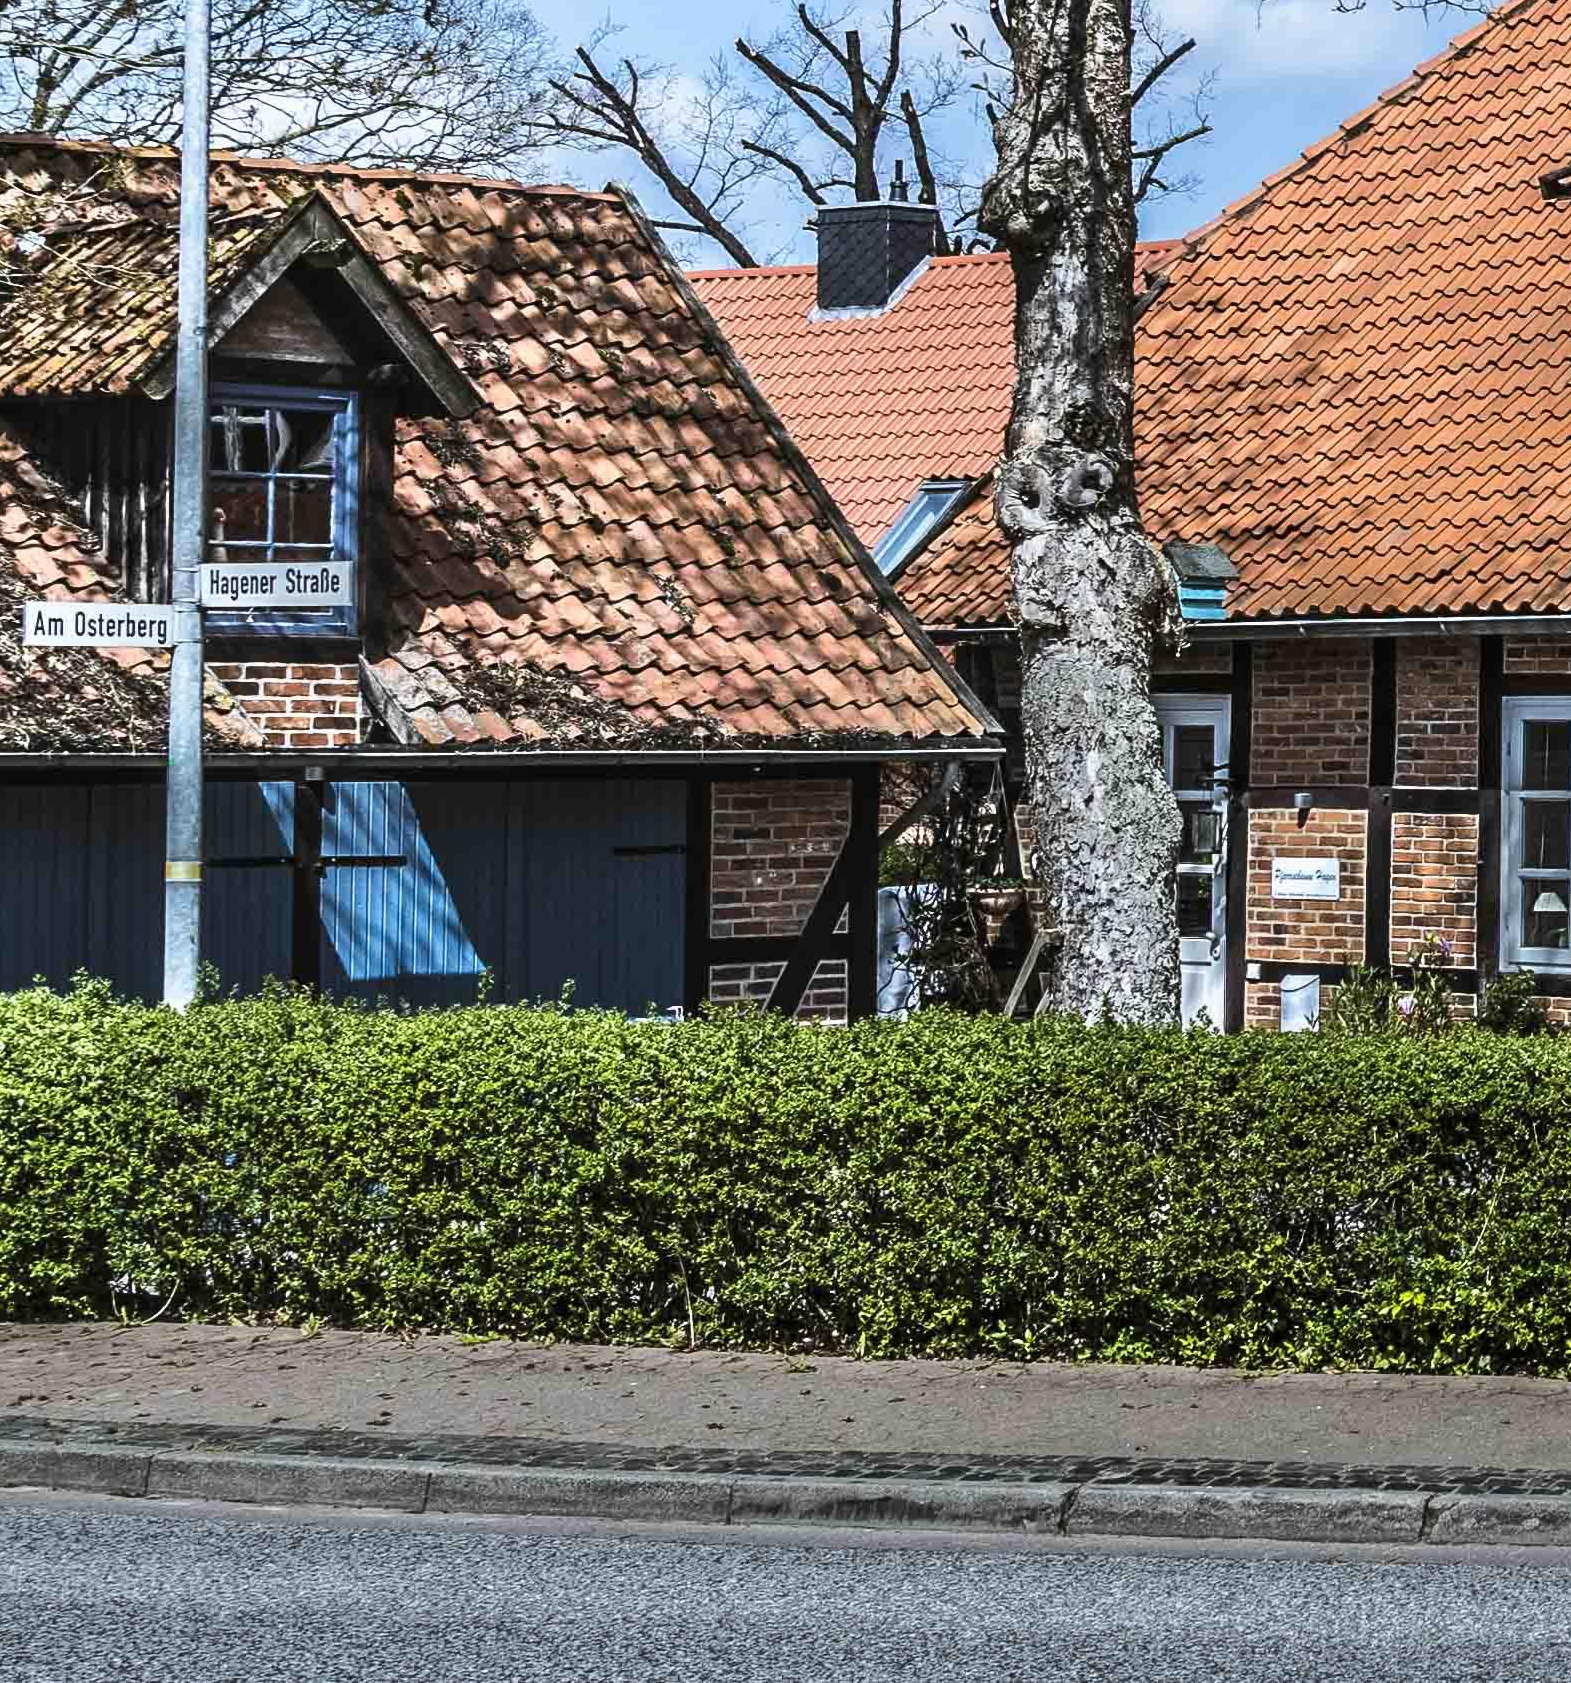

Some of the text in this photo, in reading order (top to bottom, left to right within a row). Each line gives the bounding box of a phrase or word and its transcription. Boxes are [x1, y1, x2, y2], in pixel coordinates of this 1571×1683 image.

[210, 568, 340, 600] Hagener Straße
[34, 611, 168, 644] Am Osterberg
